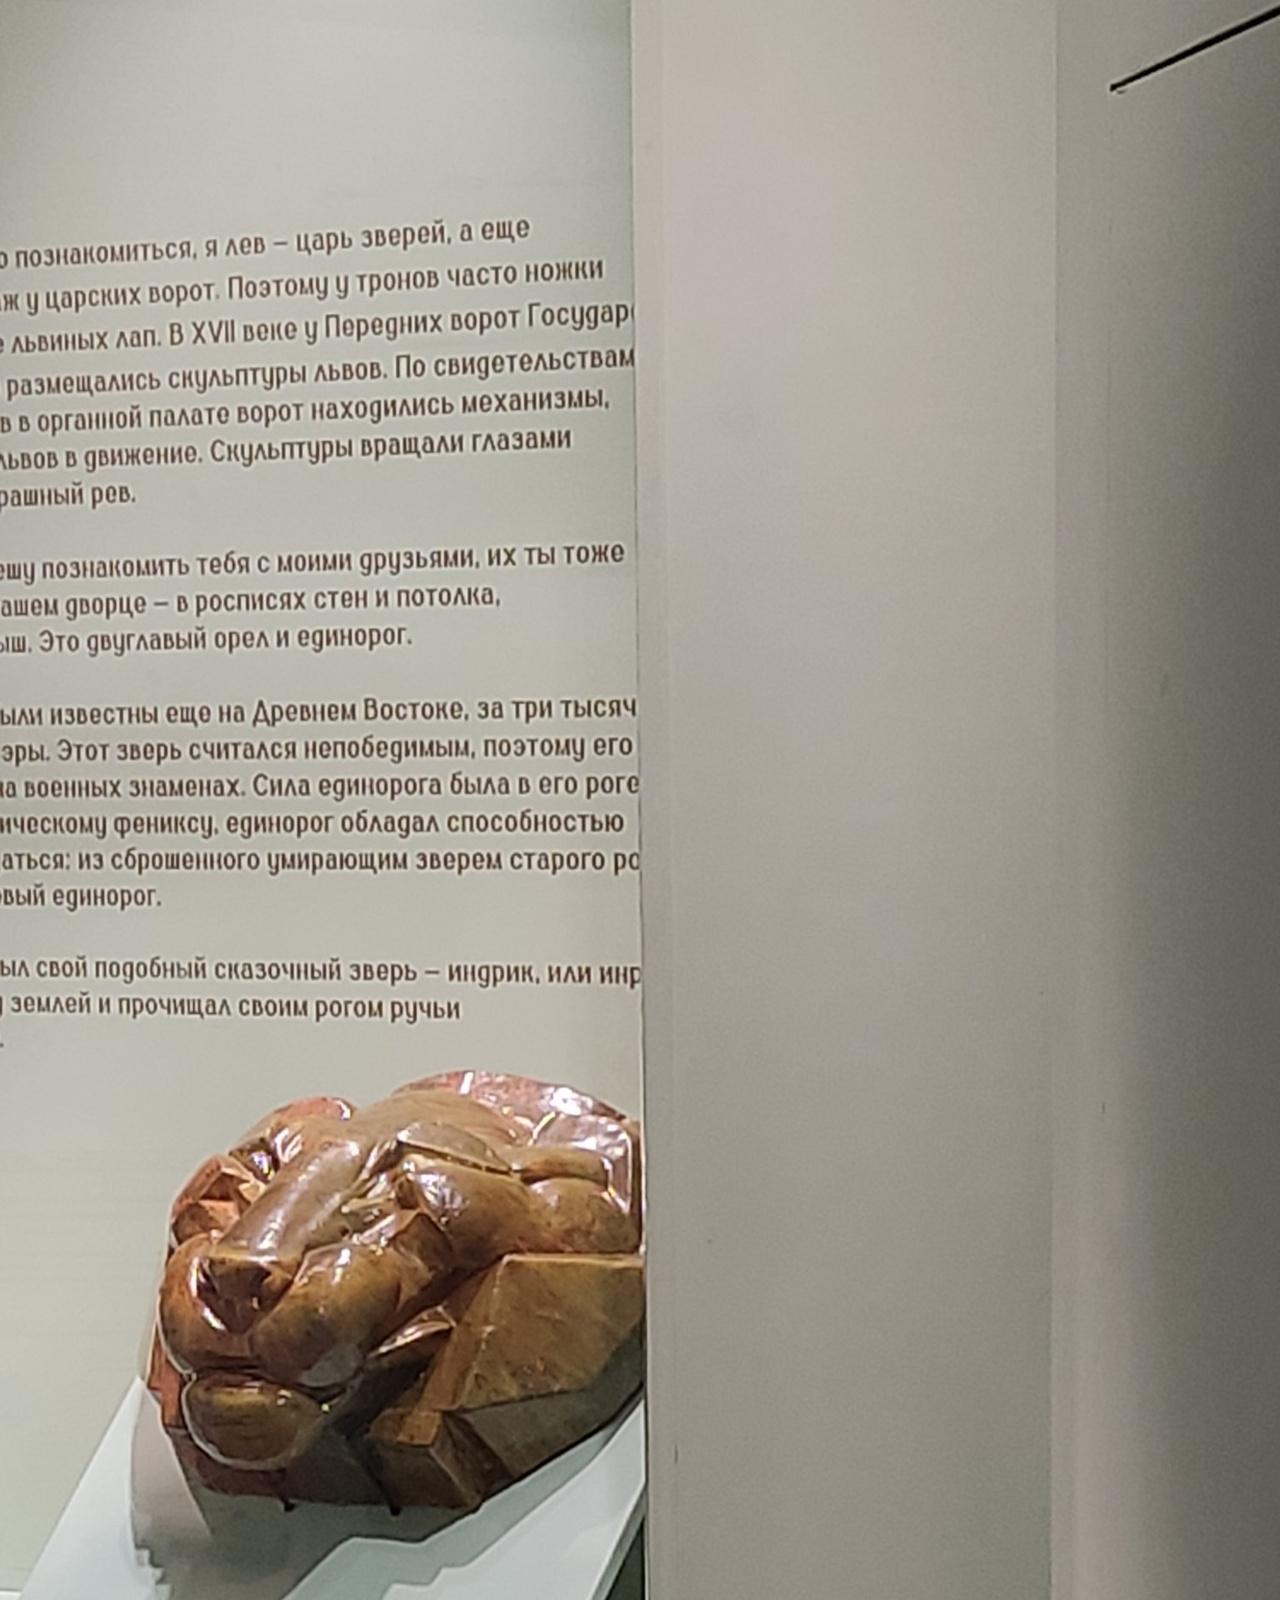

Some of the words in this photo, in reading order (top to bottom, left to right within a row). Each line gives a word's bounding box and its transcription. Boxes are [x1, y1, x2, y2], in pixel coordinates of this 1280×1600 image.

[14, 240, 198, 269] познакомиться,
[224, 236, 266, 257] лев
[296, 230, 353, 257] царь
[361, 218, 452, 252] зверей,
[480, 218, 531, 244] еще
[45, 286, 142, 314] царских
[148, 282, 221, 309] ворот.
[227, 274, 329, 302] Поэтому
[355, 269, 440, 298] тронов
[446, 264, 518, 287] часто
[525, 259, 604, 284] ножки
[11, 330, 109, 354] львиных
[115, 328, 162, 350] лап.
[168, 321, 185, 347] В
[190, 318, 236, 345] XVII
[242, 321, 298, 343] веке
[324, 313, 443, 343] Передних
[450, 309, 522, 337] ворот
[527, 301, 635, 332] Государ
[6, 372, 162, 402] размещались
[167, 364, 307, 395] скульптуры
[313, 361, 389, 383] львов.
[395, 353, 427, 379] По
[433, 347, 636, 382] свидетельствам
[37, 403, 143, 438] органной
[148, 405, 230, 429] палате
[236, 402, 305, 429] ворот
[310, 395, 455, 425] находились
[461, 388, 610, 415] механизмы,
[83, 444, 204, 474] движение.
[209, 437, 354, 468] Скульптуры
[360, 433, 464, 463] вращали
[471, 429, 572, 453] глазами
[90, 484, 136, 511] рев.
[41, 557, 191, 580] познакомить
[195, 549, 251, 577] тебя
[277, 552, 353, 574] моими
[359, 548, 481, 578] друзьями,
[487, 546, 517, 567] их
[522, 546, 556, 566] ты
[562, 543, 626, 565] тоже
[64, 595, 148, 622] дворце
[195, 590, 307, 619] росписях
[313, 588, 369, 610] стен
[396, 586, 501, 608] потолка,
[38, 629, 80, 653] Это
[86, 624, 207, 658] двуглавый
[213, 629, 270, 655] орел
[296, 626, 413, 654] единорог.
[49, 705, 159, 726] известны
[165, 704, 212, 729] еще
[217, 704, 246, 724] на
[251, 699, 357, 729] Древнем
[363, 696, 470, 723] Востоке,
[476, 700, 505, 720] за
[510, 699, 553, 725] три
[559, 697, 637, 720] тысяч
[1, 743, 51, 769] эры.
[56, 738, 111, 763] Этот
[116, 742, 183, 767] зверь
[188, 740, 297, 761] считался
[303, 733, 476, 765] непобедимым,
[483, 736, 586, 763] поэтому
[593, 736, 634, 757] его
[23, 778, 123, 799] военных
[128, 777, 247, 799] знаменах.
[252, 772, 312, 798] Сила
[317, 776, 443, 803] единорога
[449, 769, 511, 796] была
[538, 775, 579, 796] его
[585, 774, 640, 801] роге
[113, 814, 220, 841] фениксу,
[225, 814, 336, 841] единорог
[340, 808, 441, 840] обладал
[446, 807, 625, 834] способностью
[77, 851, 105, 871] из
[110, 845, 261, 877] сброшенного
[266, 851, 409, 877] умирающим
[415, 851, 503, 876] зверем
[509, 851, 606, 876] старого
[52, 887, 162, 913] единорог.
[35, 954, 88, 979] свой
[94, 955, 208, 985] подобный
[214, 956, 342, 982] сказочный
[348, 962, 418, 988] зверь
[447, 963, 541, 989] индрик,
[547, 964, 592, 985] или
[10, 990, 92, 1015] землей
[117, 996, 232, 1020] прочищал
[238, 998, 309, 1018] своим
[314, 999, 384, 1024] рогом
[390, 1000, 461, 1026] ручьи
